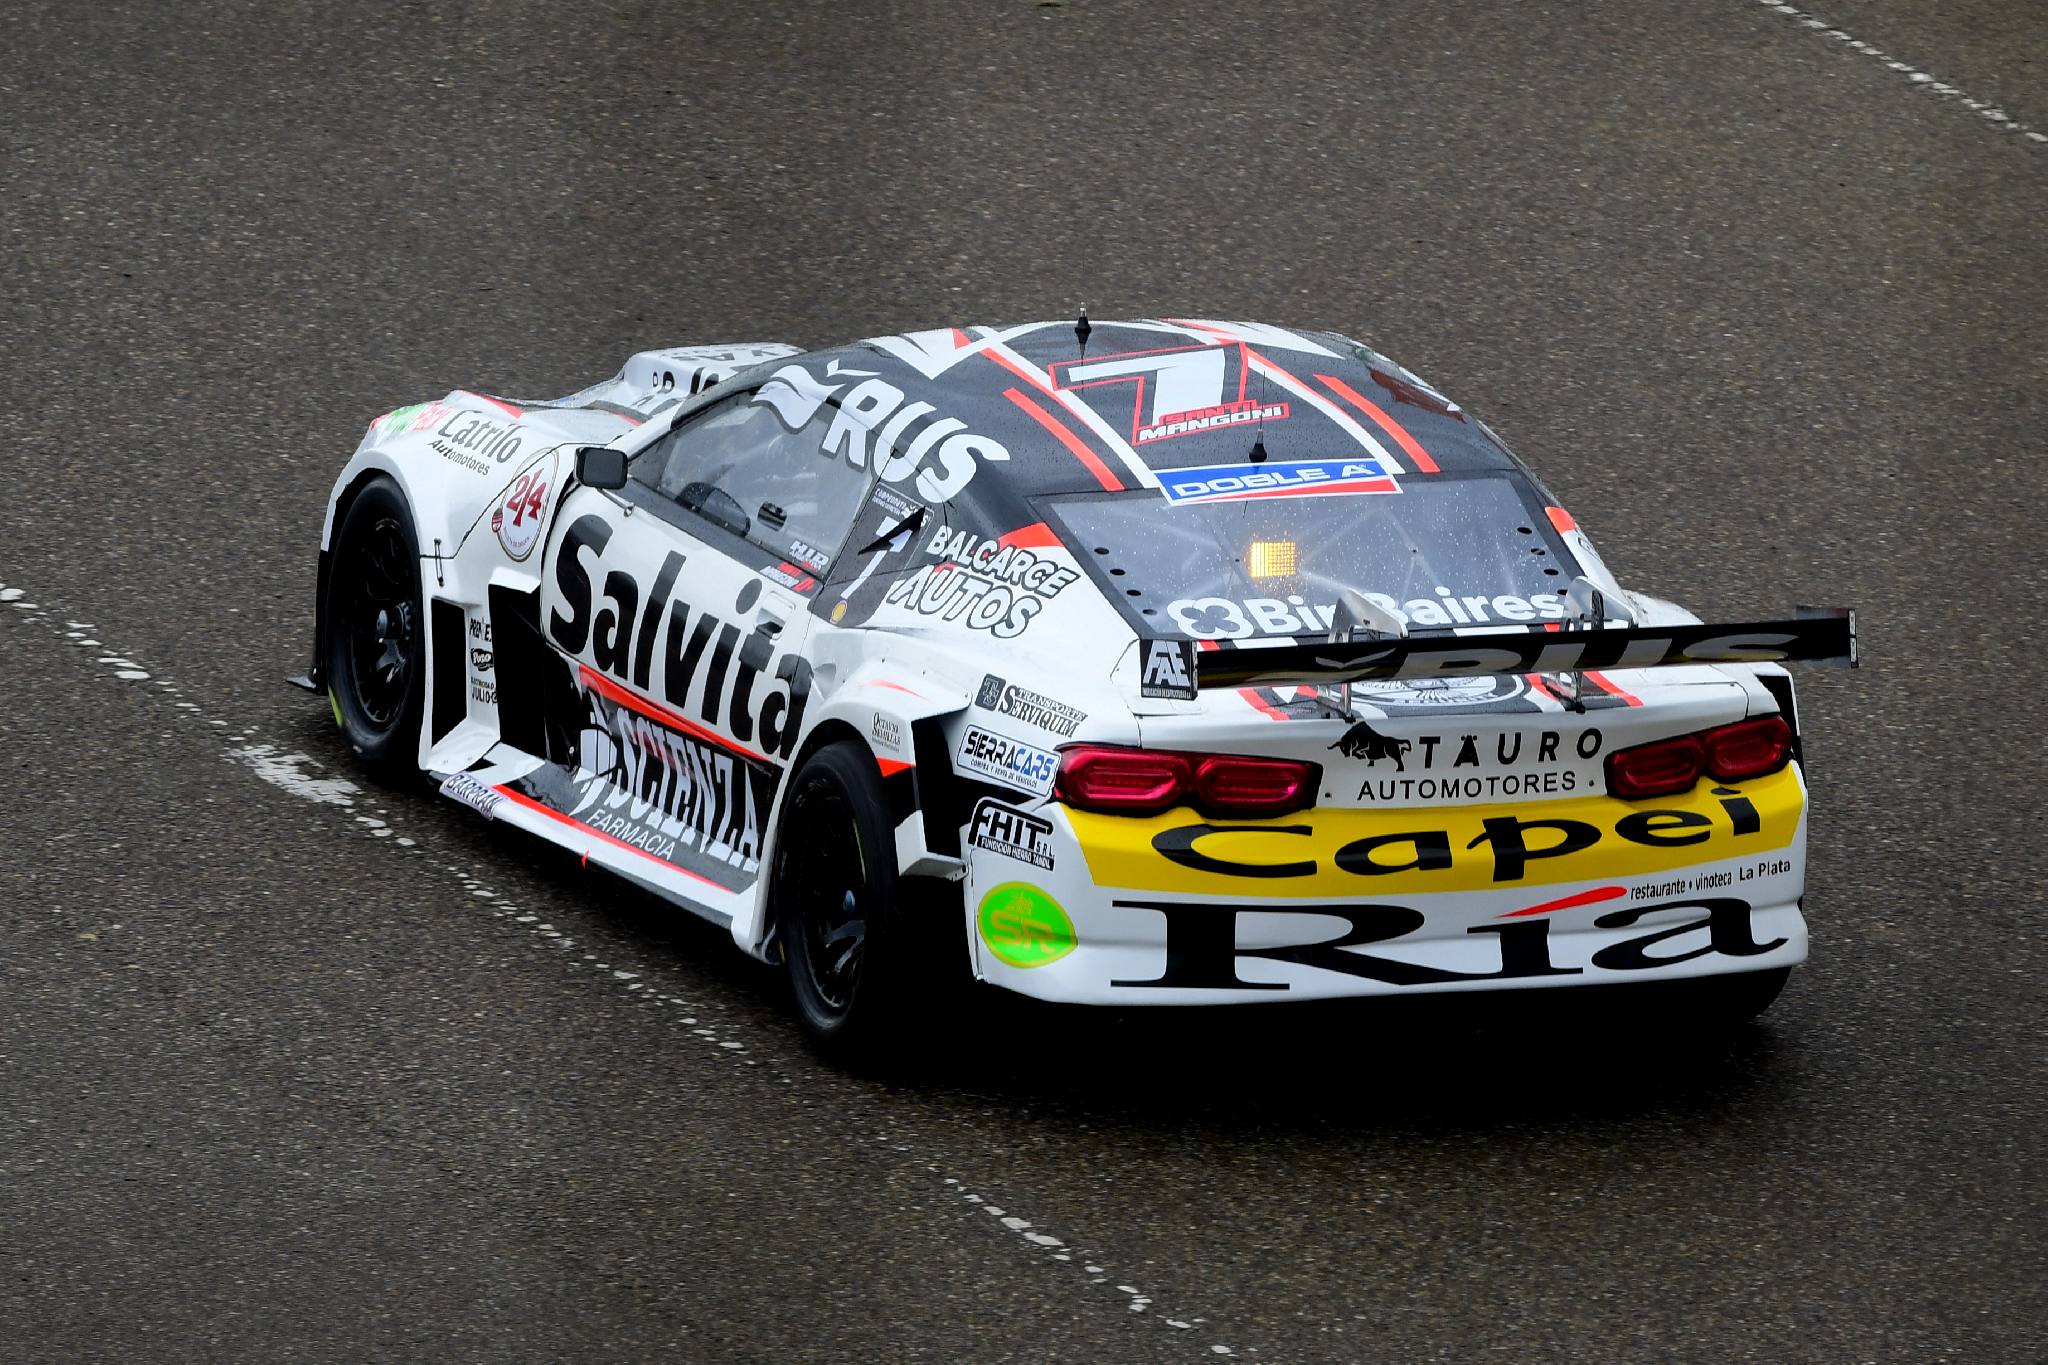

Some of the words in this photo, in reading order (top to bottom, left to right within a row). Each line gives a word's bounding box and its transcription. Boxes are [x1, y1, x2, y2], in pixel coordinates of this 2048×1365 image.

[821, 378, 1011, 503] RUS
[1139, 406, 1283, 441] MANGONI
[427, 440, 490, 476] Automotores
[1173, 467, 1331, 496] DOBLE
[1341, 464, 1376, 478] A
[926, 525, 1081, 599] BALCARCE
[886, 565, 1042, 639] AUTOS
[549, 514, 814, 757] Salvita
[1142, 640, 1190, 687] FAE
[998, 684, 1080, 738] SERVIQUIM
[964, 731, 1055, 781] SIERRACARS
[1357, 771, 1576, 800] AUTOMOTORES
[586, 809, 676, 860] FARMACIA
[1151, 787, 1761, 882] Capei
[1630, 878, 1686, 901] restaurante
[1695, 871, 1732, 891] vinoteca
[1739, 866, 1754, 882] La
[1758, 859, 1791, 878] Plata
